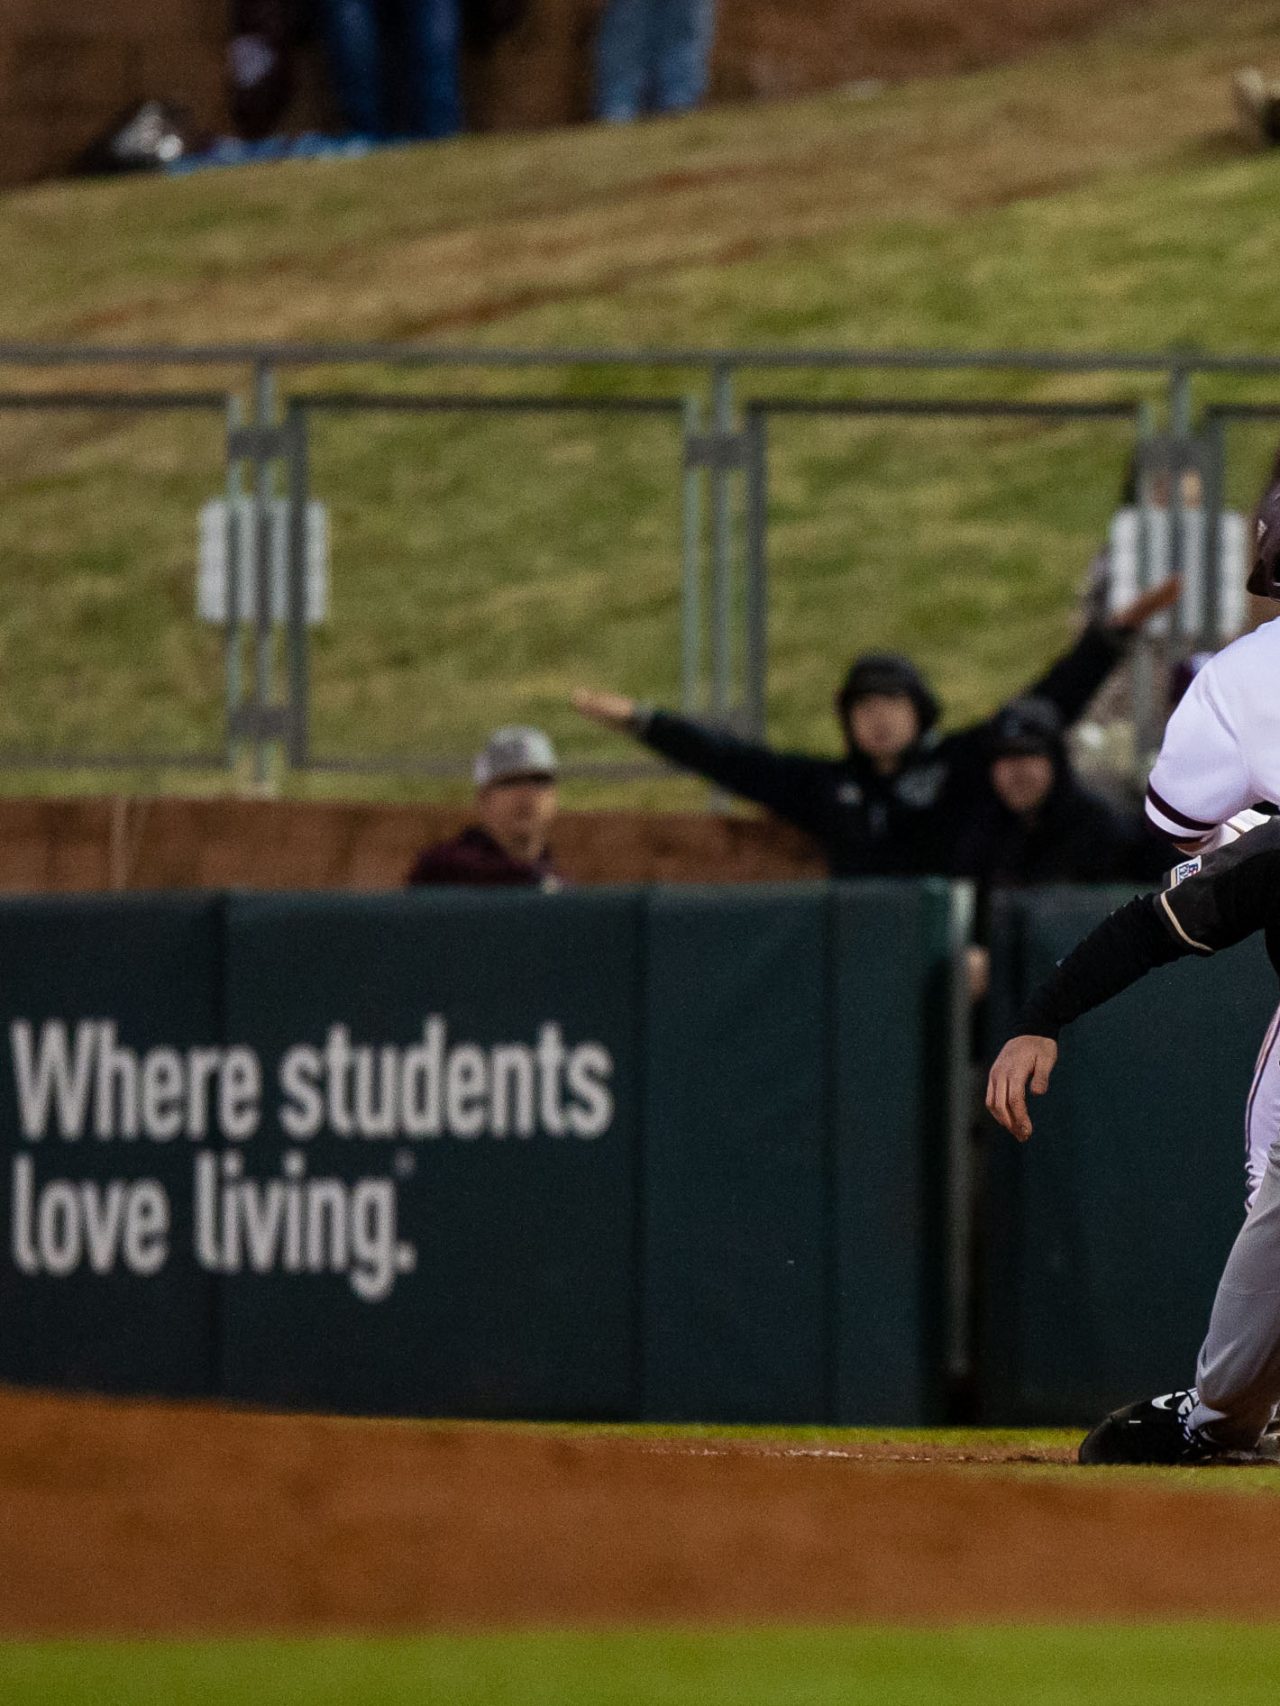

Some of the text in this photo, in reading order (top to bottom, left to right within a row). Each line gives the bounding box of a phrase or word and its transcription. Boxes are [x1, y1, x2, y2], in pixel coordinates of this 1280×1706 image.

[11, 1013, 615, 1141] Where students
[12, 1149, 418, 1300] love living.
